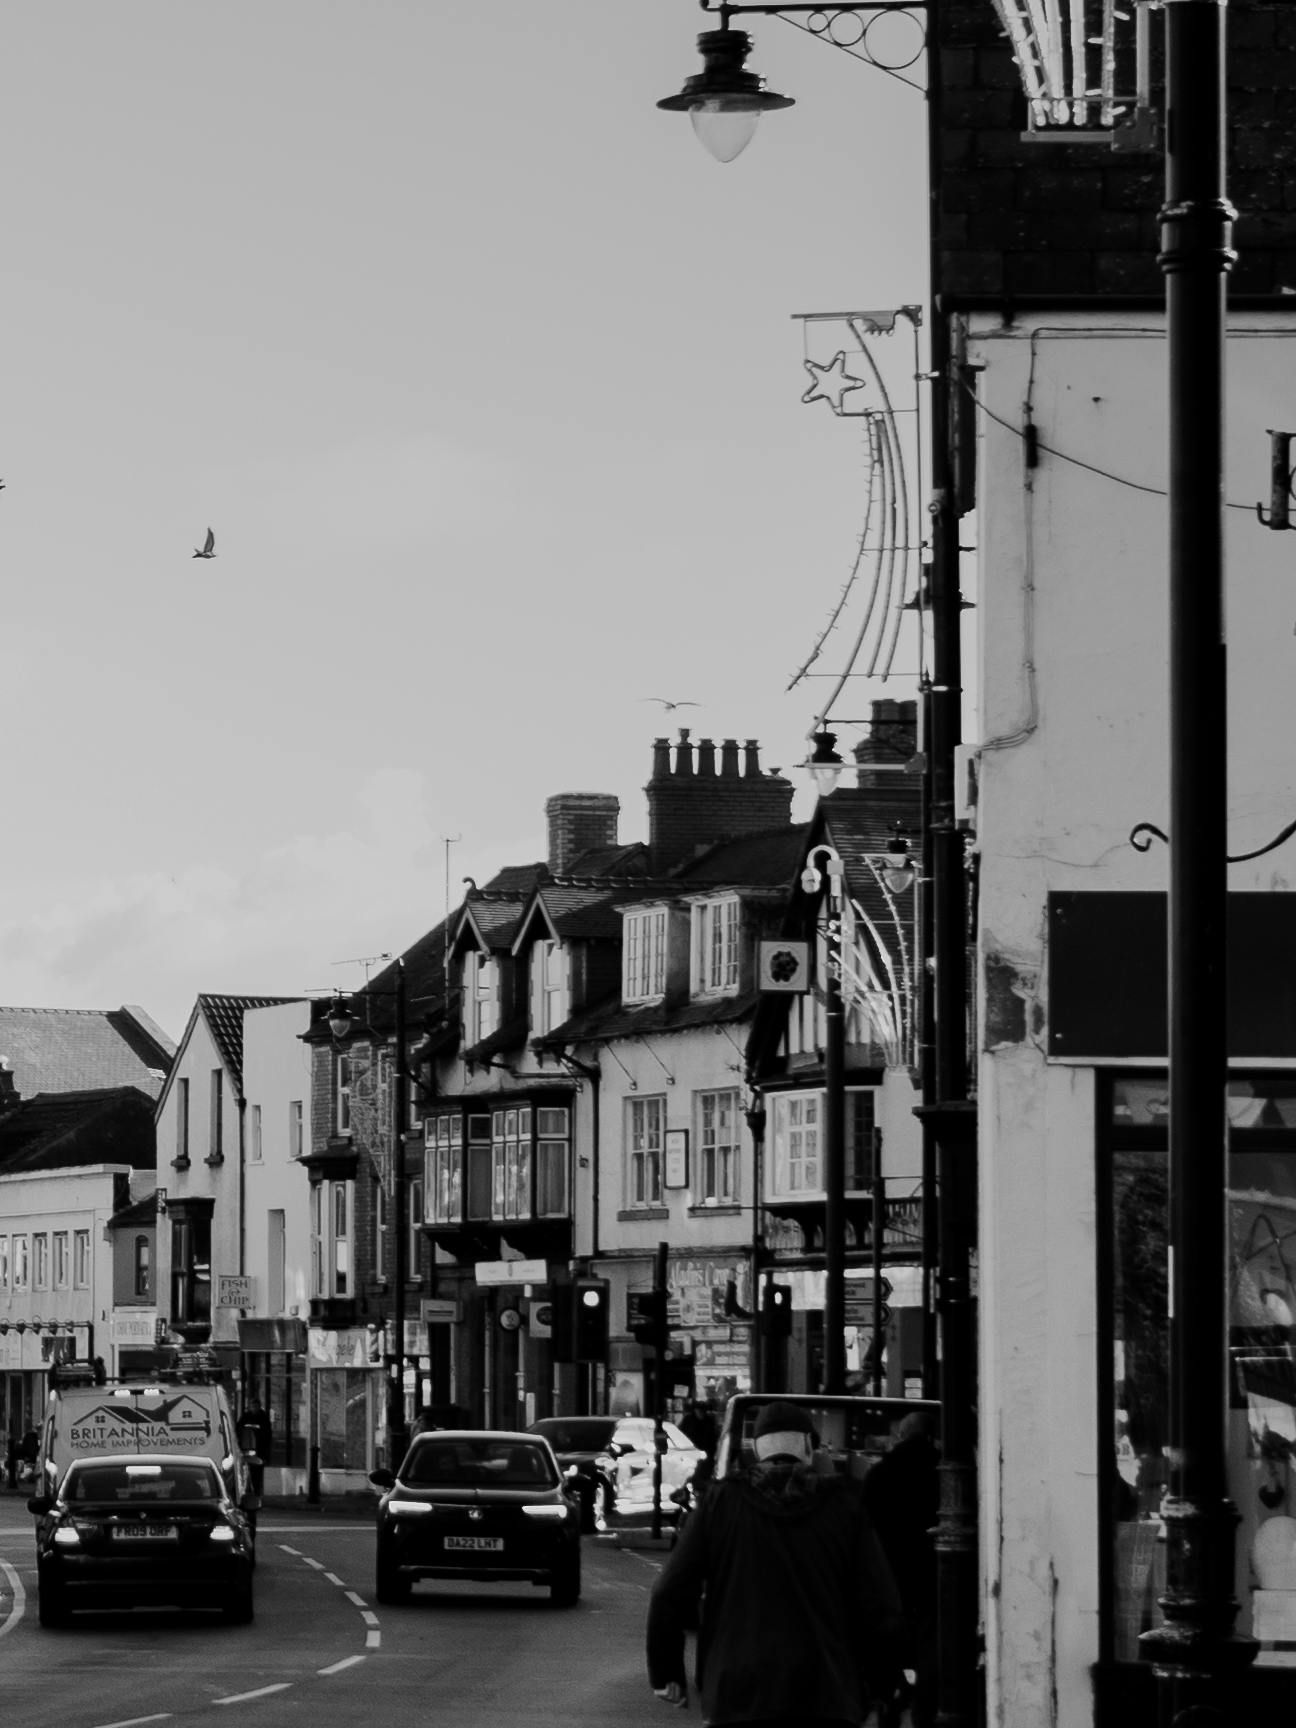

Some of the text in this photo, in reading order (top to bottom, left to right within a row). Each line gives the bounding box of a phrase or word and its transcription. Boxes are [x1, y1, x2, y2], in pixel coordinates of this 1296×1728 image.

[70, 1426, 169, 1440] BRITANNIA
[70, 1436, 206, 1449] HOME IMPROVEMENTS
